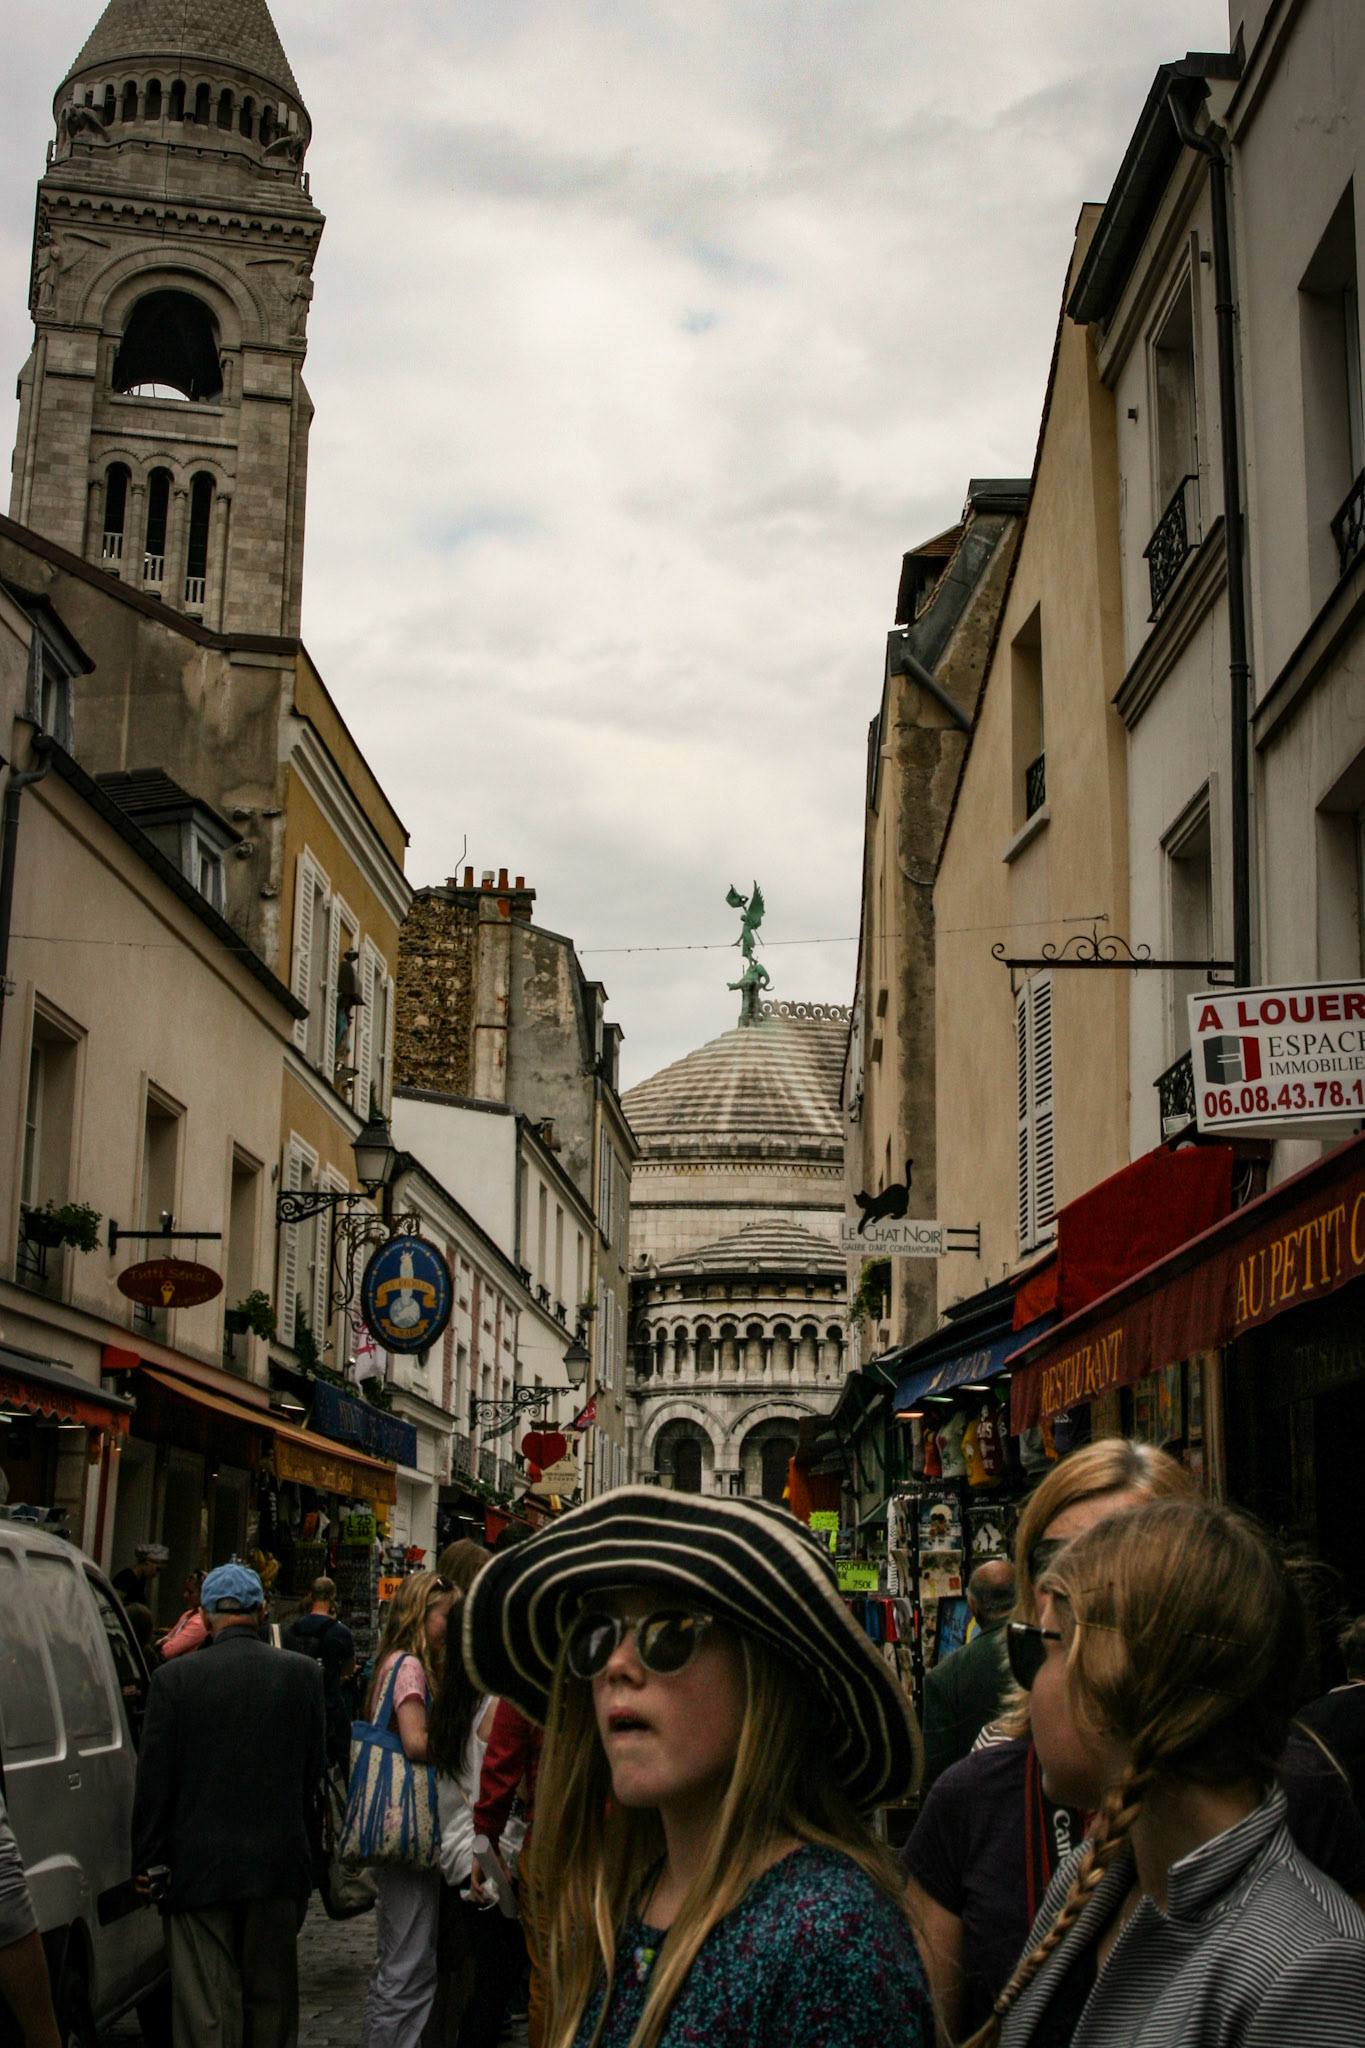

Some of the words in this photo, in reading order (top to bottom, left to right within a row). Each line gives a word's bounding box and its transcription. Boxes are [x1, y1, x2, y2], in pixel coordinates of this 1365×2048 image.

[1197, 1004, 1224, 1032] A
[1237, 993, 1365, 1028] LOUER
[1204, 1079, 1365, 1118] 06.08.43.78.1
[841, 1223, 856, 1241] LE
[862, 1224, 901, 1242] CHAT
[903, 1226, 942, 1244] NOIR
[841, 1243, 866, 1252] GALERIE
[1235, 1250, 1266, 1325] AU
[1269, 1202, 1346, 1308] PETIT
[1041, 1327, 1123, 1417] RESTAURANT
[1053, 1809, 1071, 1857] Can
